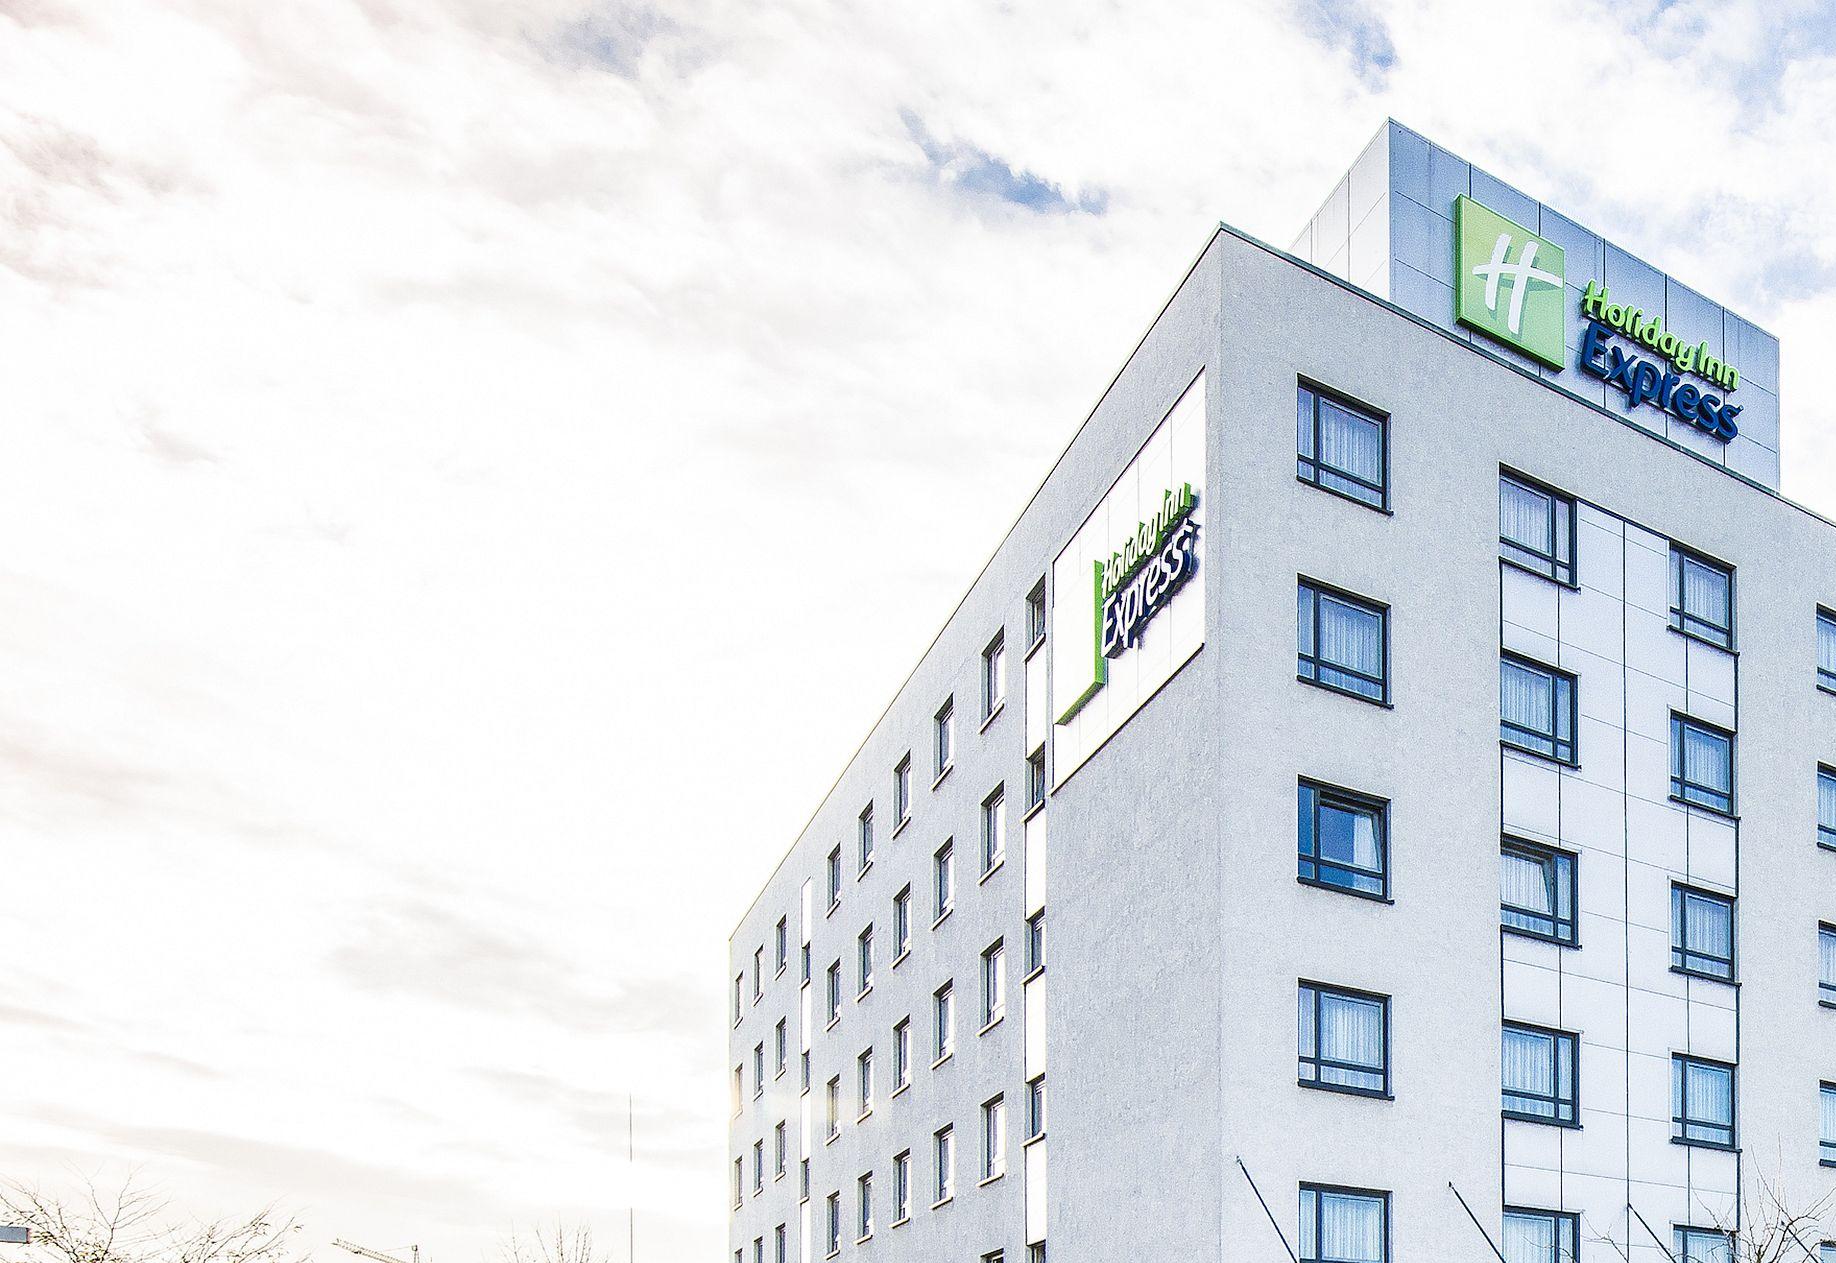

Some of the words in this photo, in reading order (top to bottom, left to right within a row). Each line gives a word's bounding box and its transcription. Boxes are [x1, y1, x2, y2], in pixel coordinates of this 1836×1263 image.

[1581, 320, 1742, 442] Express
[1585, 279, 1695, 371] Holiday
[1698, 341, 1740, 391] Inn
[1101, 512, 1161, 600] Holiday
[1159, 482, 1191, 532] Inn
[1101, 518, 1195, 658] Express
